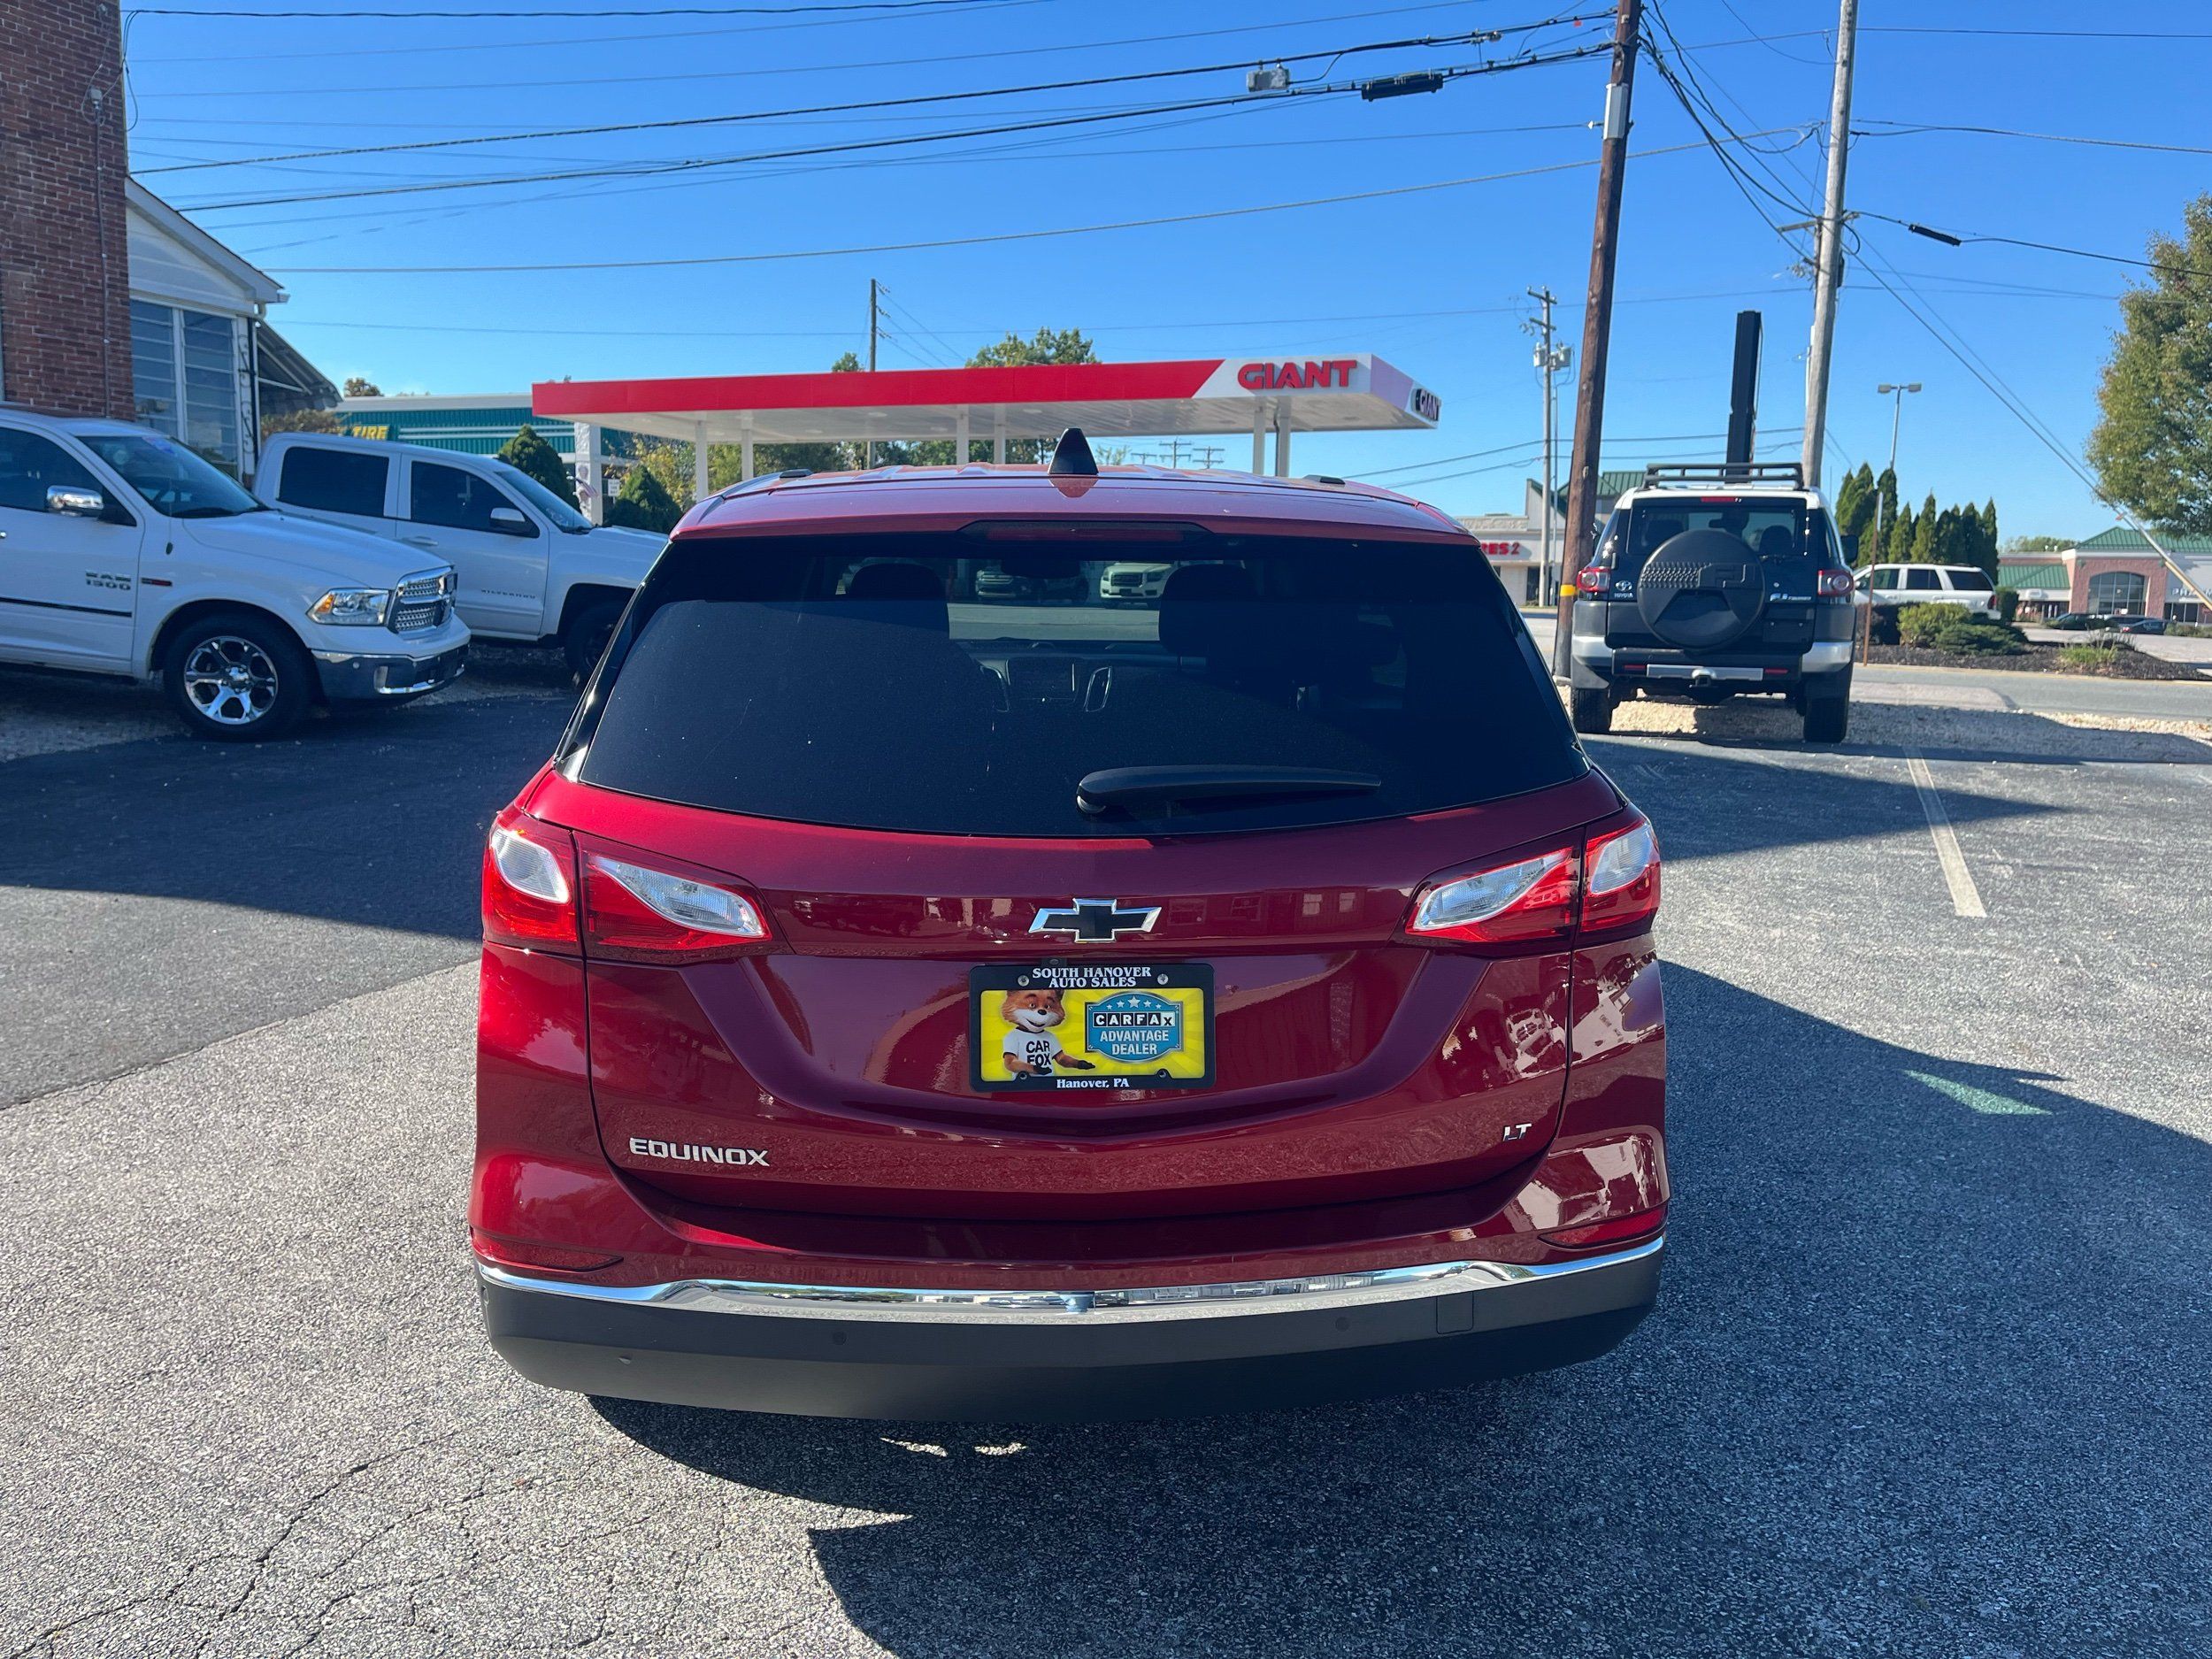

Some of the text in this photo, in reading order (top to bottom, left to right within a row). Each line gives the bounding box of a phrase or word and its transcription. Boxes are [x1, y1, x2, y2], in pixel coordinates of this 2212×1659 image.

[1237, 359, 1356, 389] GIANT
[353, 425, 389, 440] TIRE
[1511, 541, 1520, 556] 2
[1032, 966, 1152, 979] SOUTH HANOVER
[1048, 977, 1137, 988] AUTO SALES
[1094, 1013, 1174, 1026] CARFAX
[1100, 1030, 1170, 1042] ADVANTAGE
[1025, 1040, 1050, 1053] CAR
[1111, 1043, 1157, 1056] DEALER
[1026, 1053, 1052, 1067] FOX
[1056, 1078, 1130, 1089] Hanover, PA
[1502, 1123, 1532, 1141] LT
[629, 1137, 770, 1167] EQUINOX
